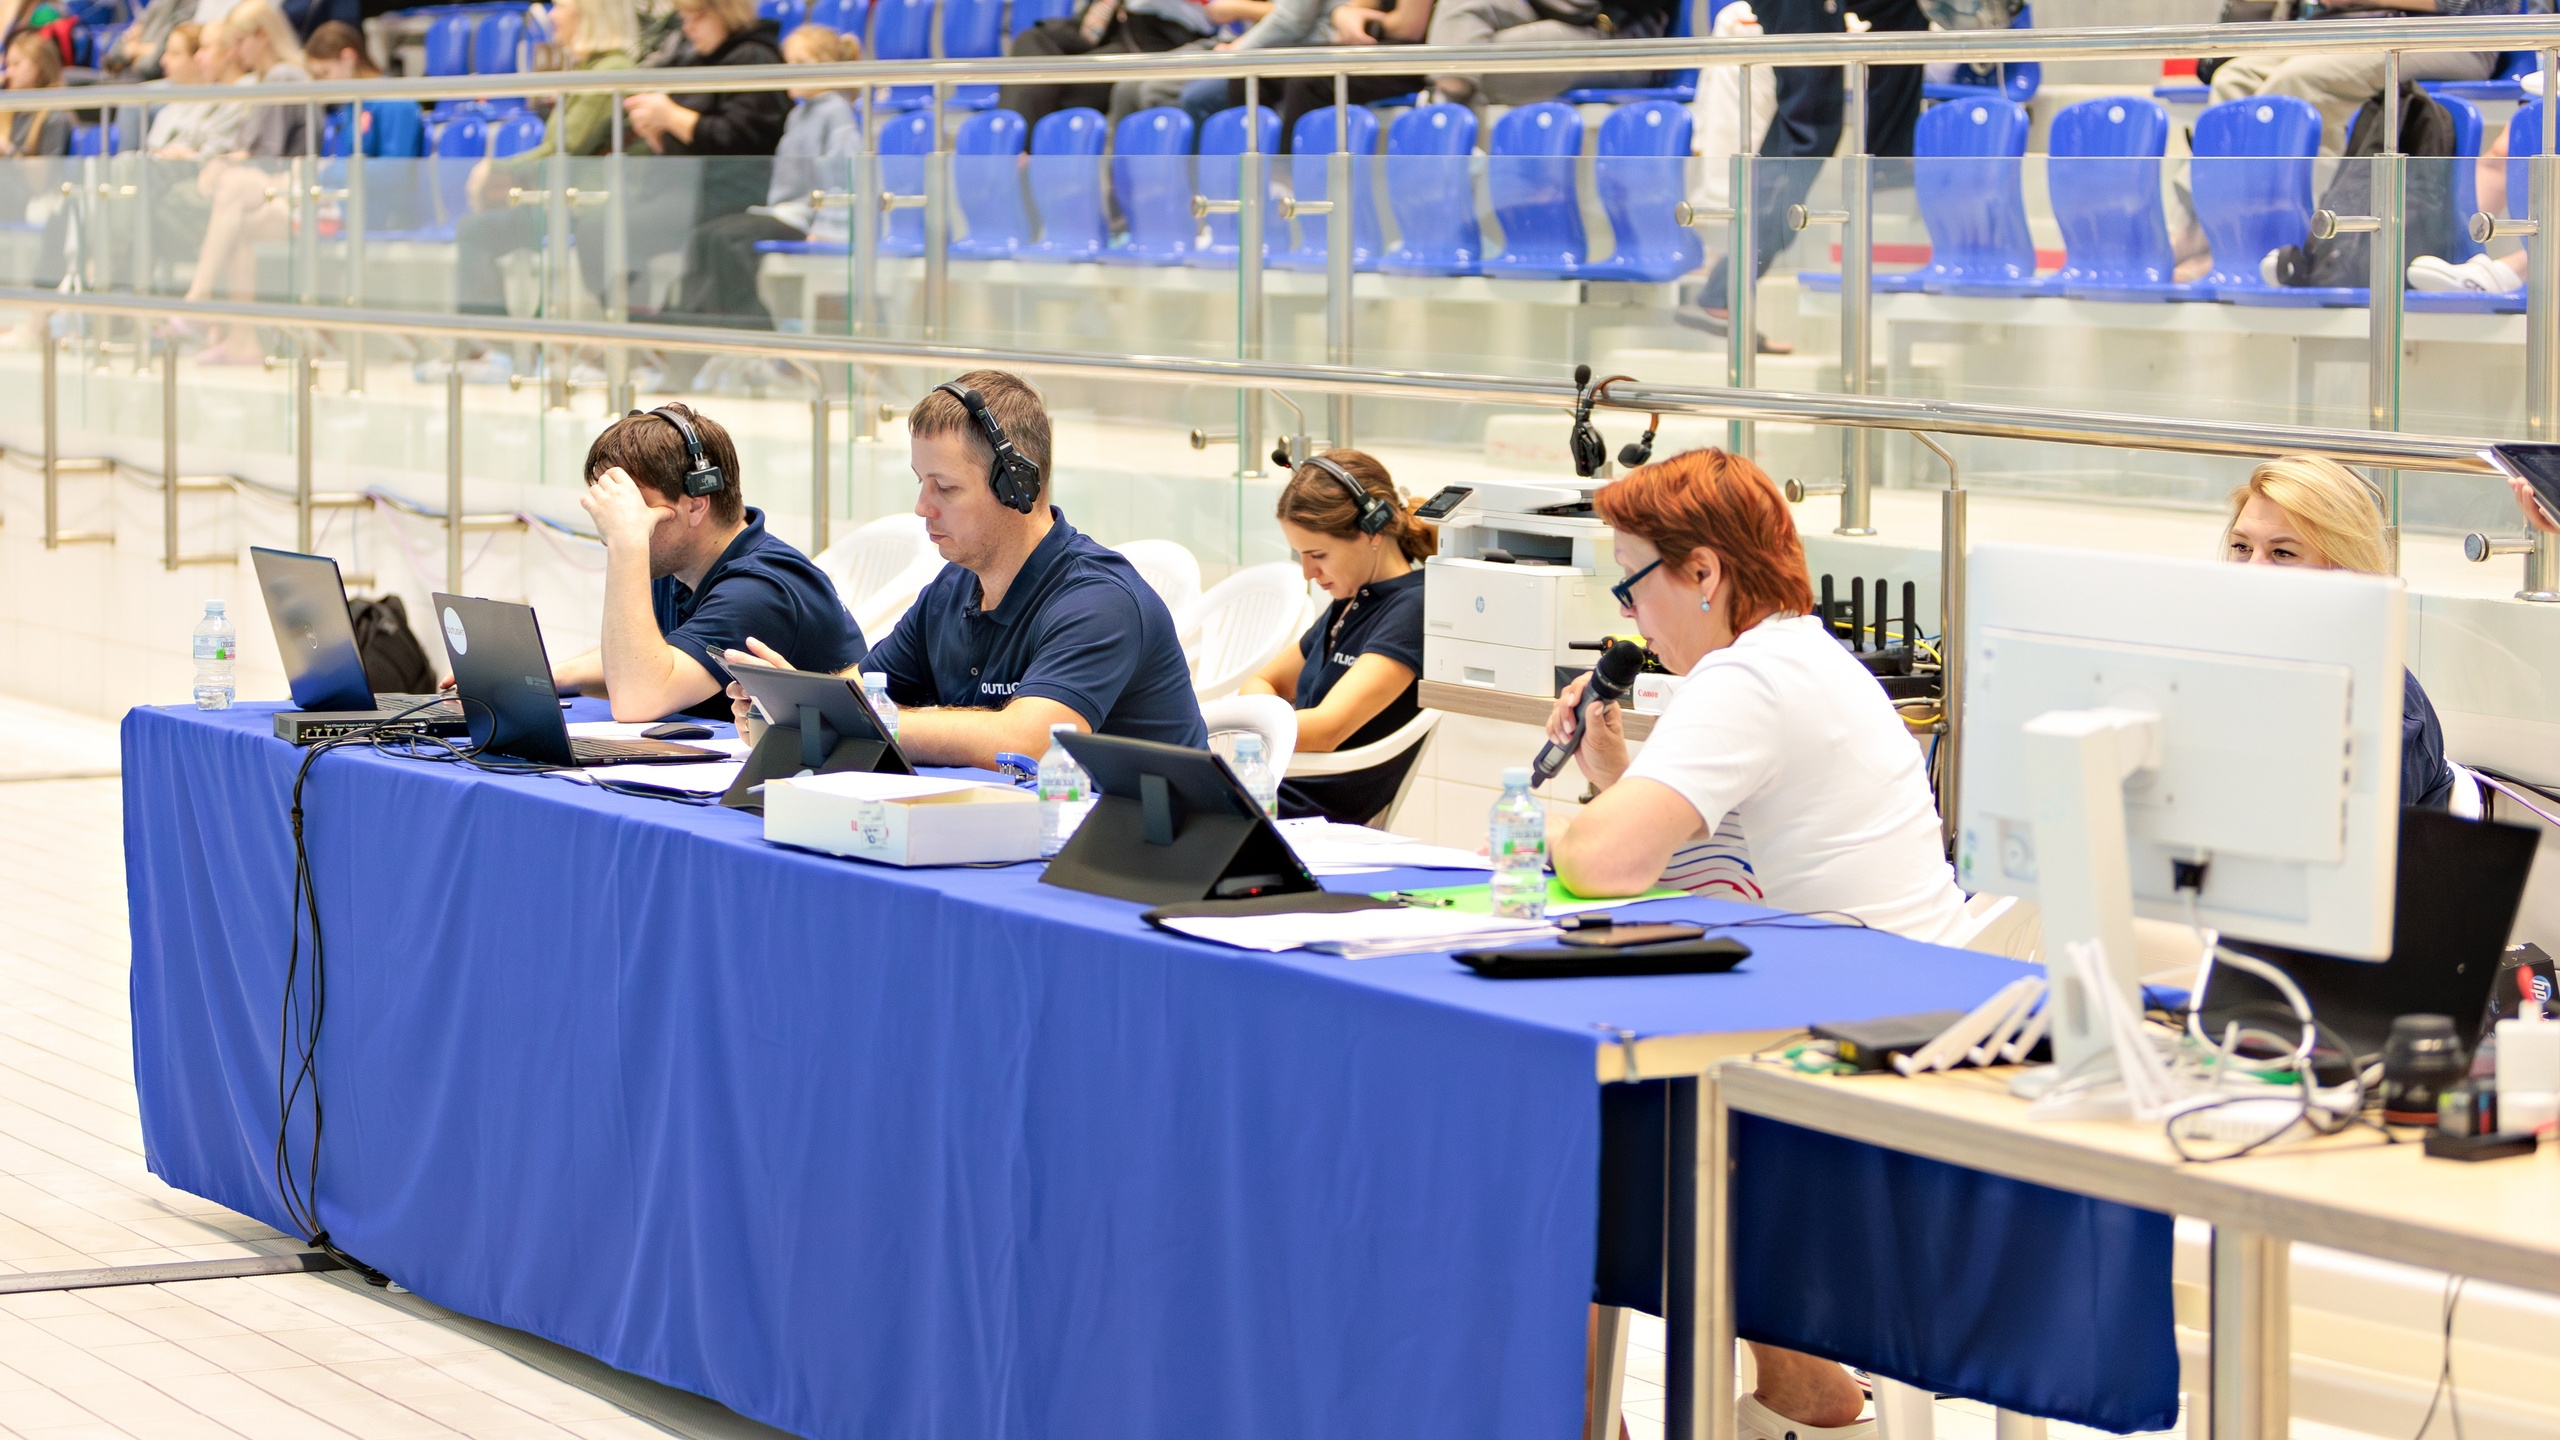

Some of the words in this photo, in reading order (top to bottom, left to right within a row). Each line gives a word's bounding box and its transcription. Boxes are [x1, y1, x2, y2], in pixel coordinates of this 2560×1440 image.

[699, 461, 707, 470] 2
[1637, 689, 1659, 698] Canon
[2529, 977, 2552, 1002] hp
